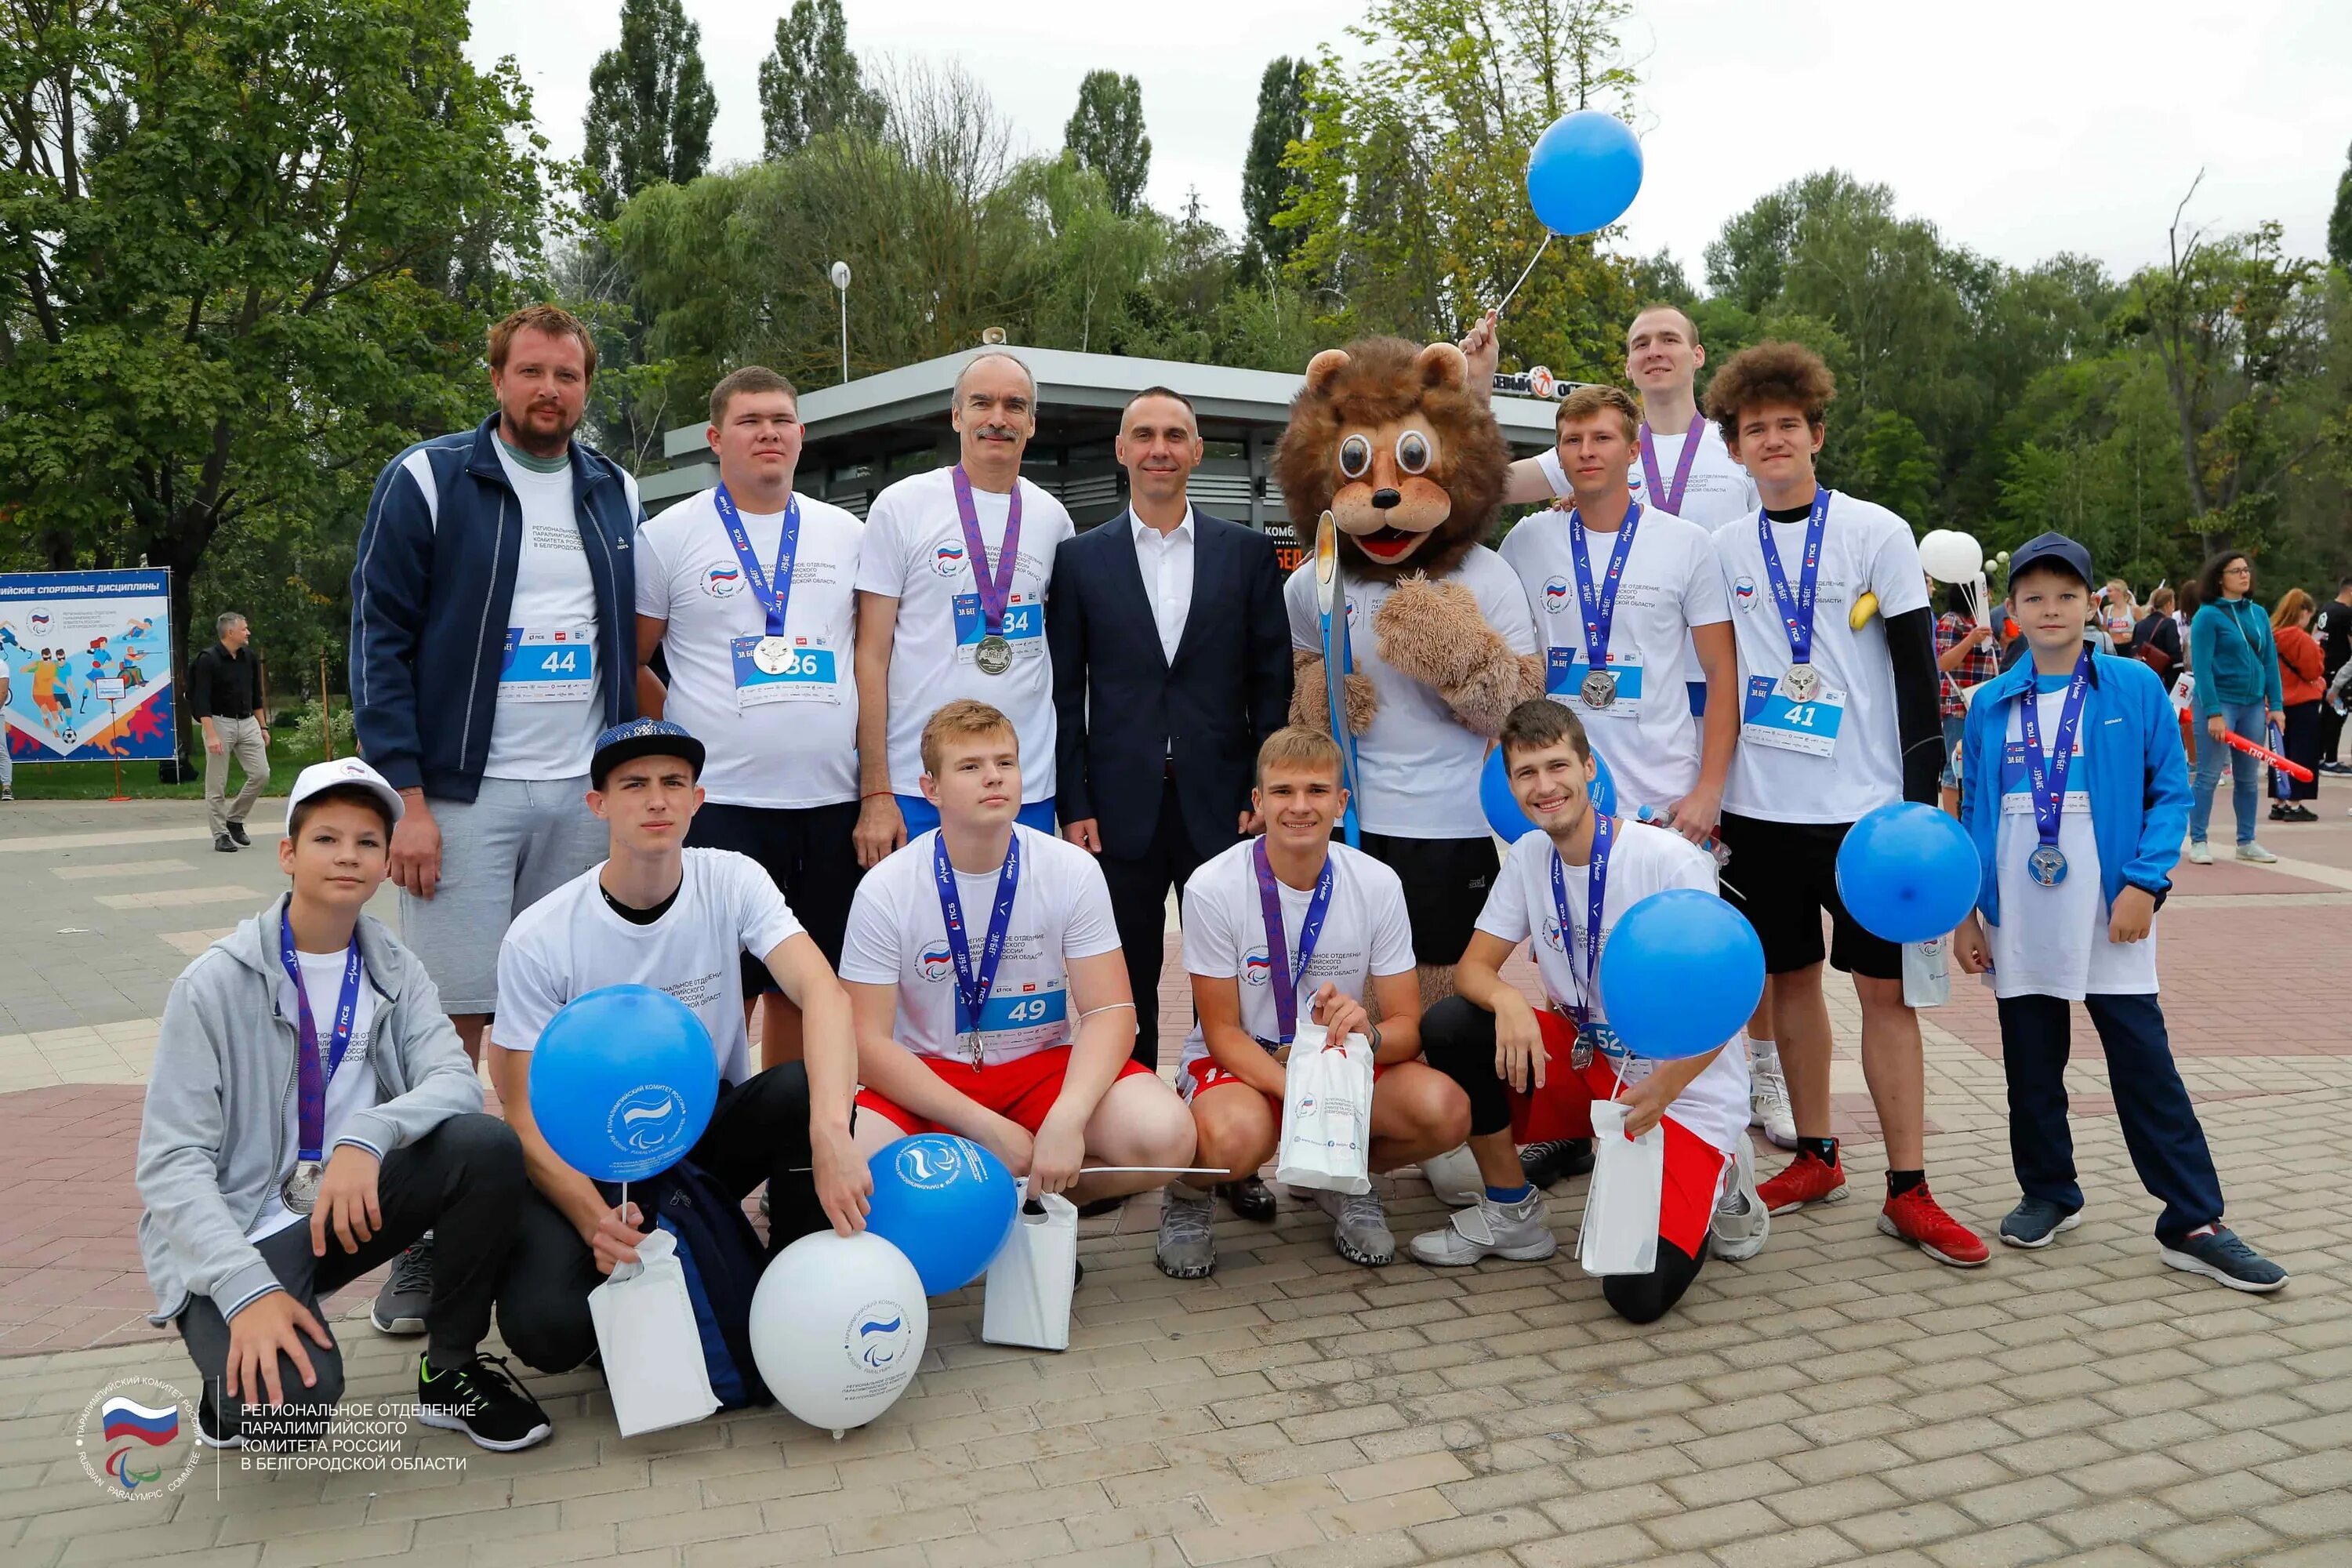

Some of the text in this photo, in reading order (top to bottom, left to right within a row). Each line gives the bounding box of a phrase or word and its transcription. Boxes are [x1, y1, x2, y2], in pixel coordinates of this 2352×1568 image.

[532, 525, 578, 535] РЕГИОНАЛЬНОЕ
[1265, 526, 1296, 537] комб
[1613, 556, 1622, 570] ПСБ
[38, 585, 94, 593] СПОРТИВНЫЕ
[97, 583, 159, 593] ДИСЦИПЛИНЫ
[1004, 612, 1029, 633] 34
[1590, 631, 1599, 647] ПСБ
[1791, 627, 1801, 642] ПСБ
[541, 651, 576, 673] 44
[1784, 705, 1817, 727] 41
[2027, 721, 2036, 739] ПСБ
[948, 902, 958, 920] ПСБ
[679, 993, 705, 1002] РОССИИ
[340, 1006, 350, 1025] ПСБ
[1008, 1000, 1047, 1022] 49
[1595, 1029, 1622, 1051] 52
